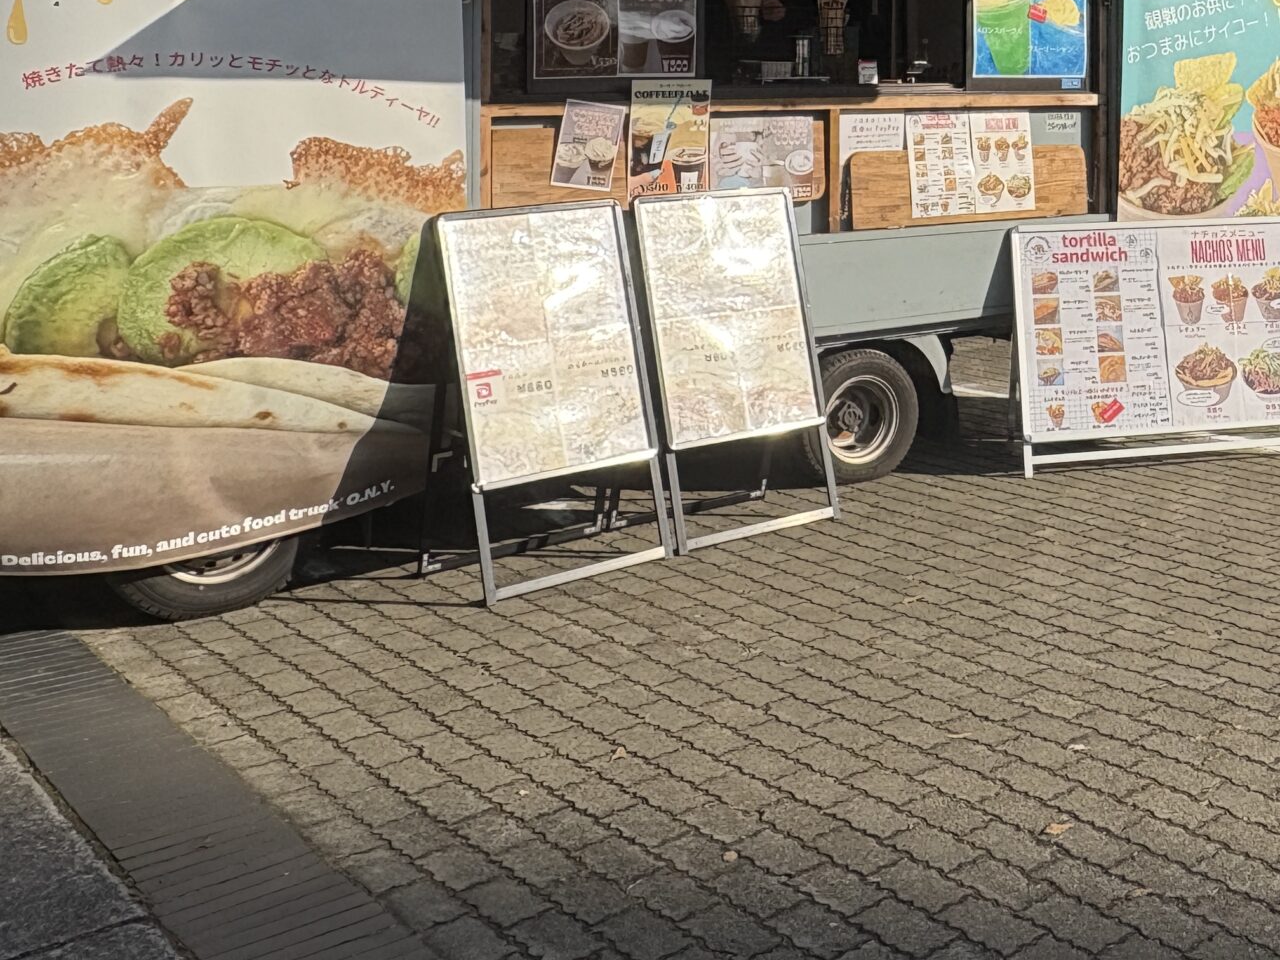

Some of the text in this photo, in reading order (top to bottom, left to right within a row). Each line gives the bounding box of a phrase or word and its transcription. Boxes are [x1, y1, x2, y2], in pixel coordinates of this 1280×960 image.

[1062, 232, 1117, 248] tortilla
[1190, 229, 1266, 239] ナチョスメニュー
[1052, 247, 1128, 264] sandwich
[1190, 237, 1266, 264] NACHOS MENU
[111, 544, 153, 559] fun,
[156, 532, 195, 552] and
[243, 510, 286, 534] food
